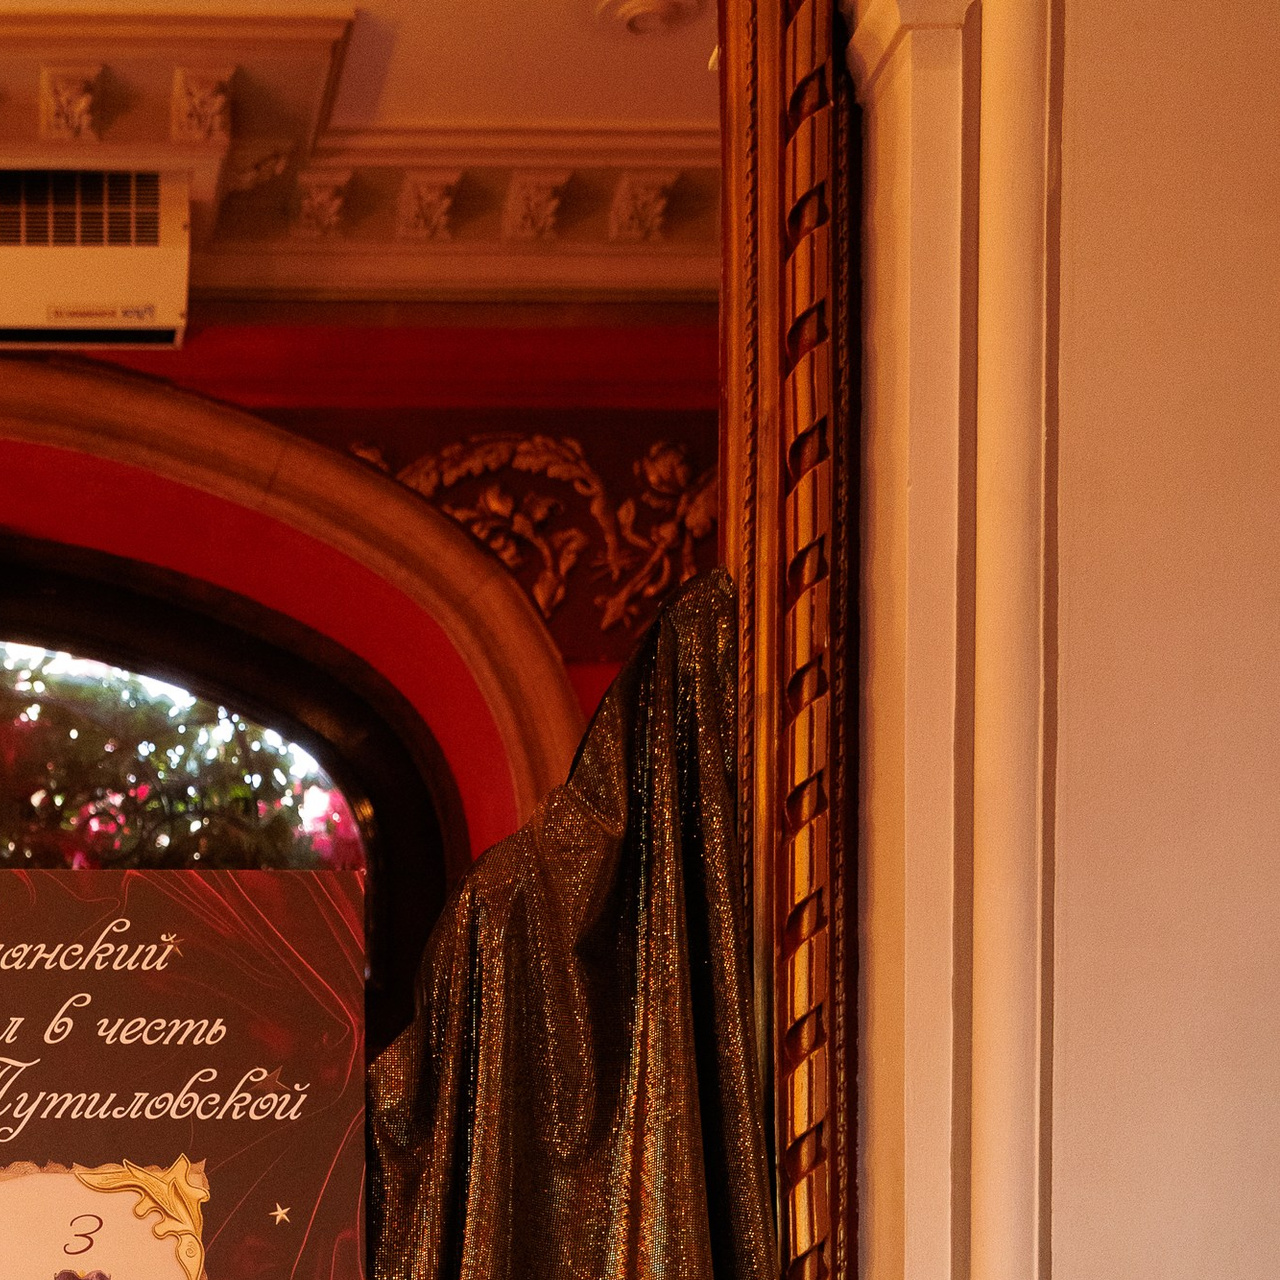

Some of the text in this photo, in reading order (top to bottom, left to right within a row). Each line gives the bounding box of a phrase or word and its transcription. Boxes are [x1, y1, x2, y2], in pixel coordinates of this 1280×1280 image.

[44, 993, 91, 1044] в
[96, 1016, 226, 1046] честь
[63, 1214, 103, 1255] 3
